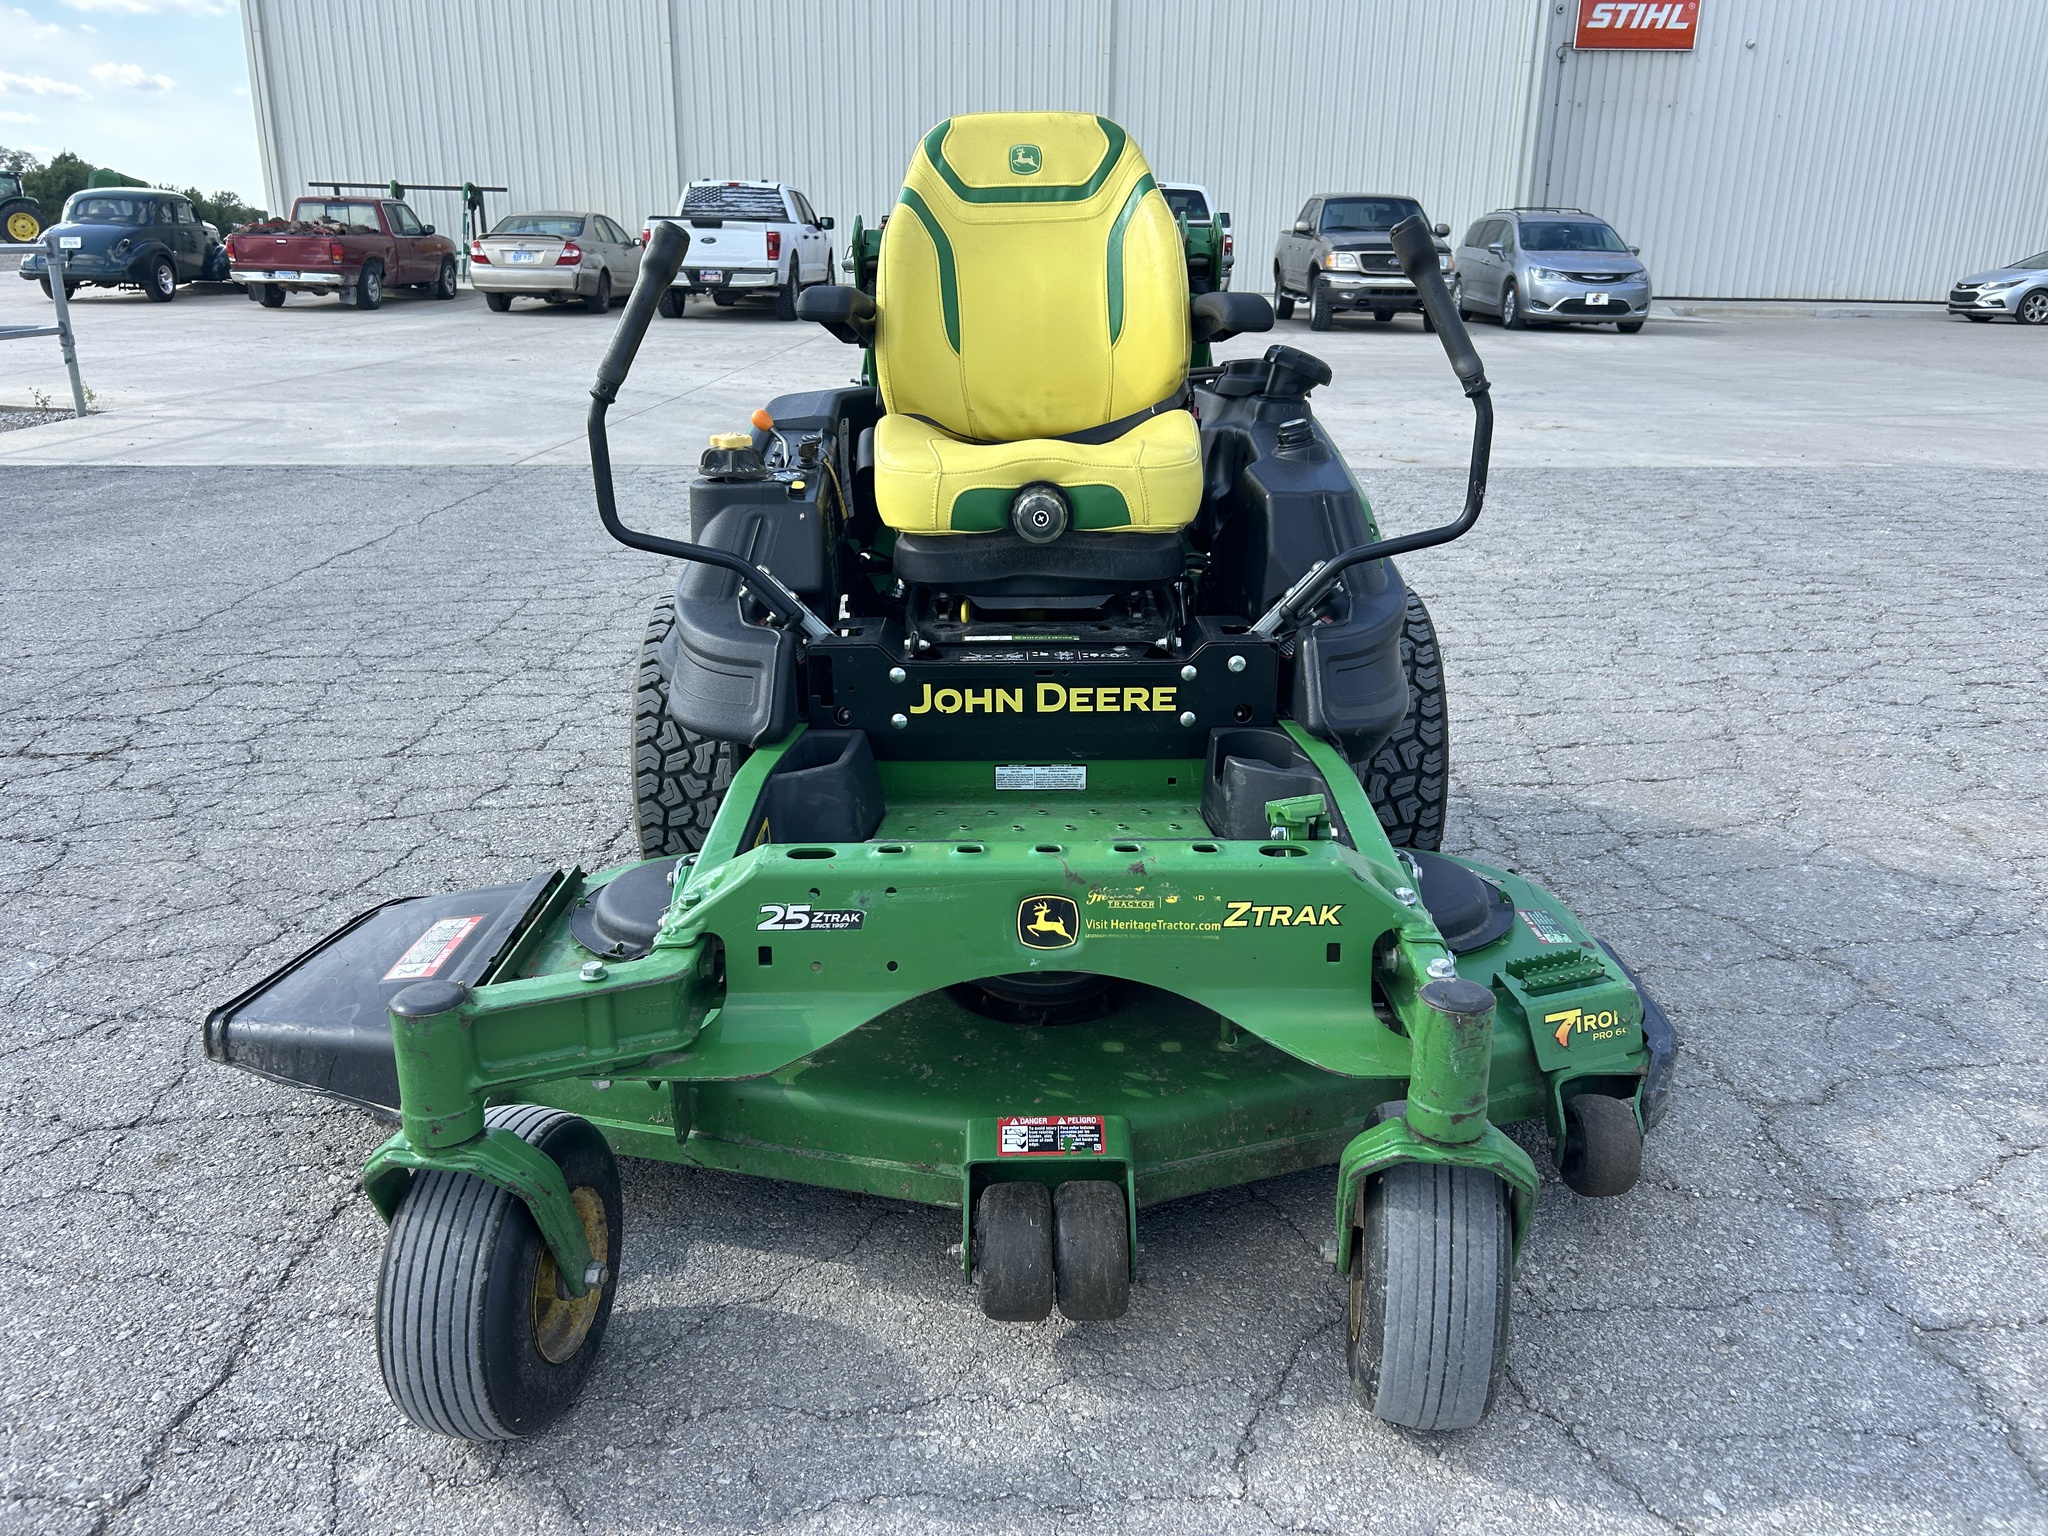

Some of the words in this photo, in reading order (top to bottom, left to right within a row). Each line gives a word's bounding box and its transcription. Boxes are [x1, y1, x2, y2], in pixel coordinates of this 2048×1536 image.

[1586, 3, 1690, 29] STIHL
[909, 683, 1024, 714] JOHN
[1036, 682, 1177, 713] DEERE
[1107, 900, 1155, 909] TRACTOR
[757, 905, 811, 931] 25
[811, 911, 861, 923] ZTRAK
[1222, 901, 1344, 928] ZTRAK
[1085, 919, 1108, 930] Visit
[1110, 919, 1221, 932] HeritageTractor.com
[1592, 1030, 1614, 1042] PRO
[1019, 1117, 1048, 1125] DANGER
[1067, 1116, 1097, 1124] PELIGRO
